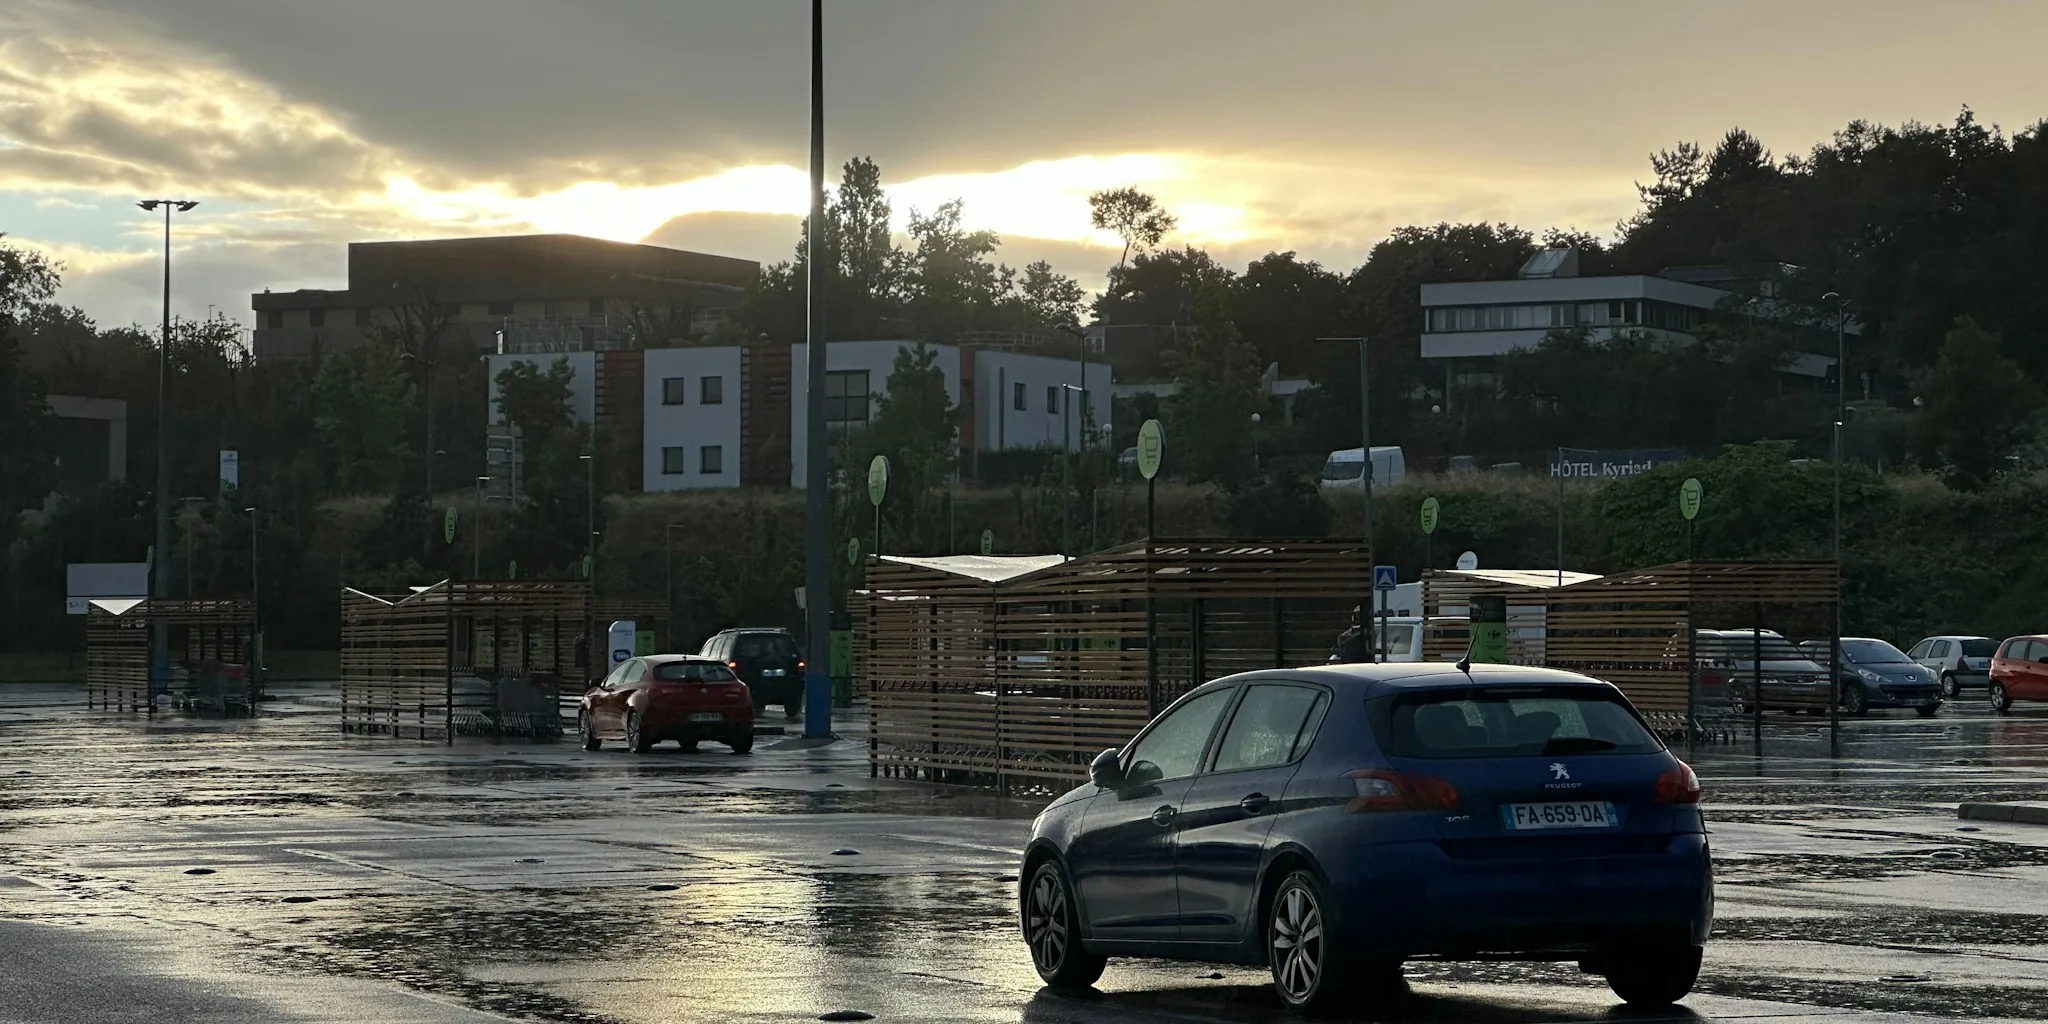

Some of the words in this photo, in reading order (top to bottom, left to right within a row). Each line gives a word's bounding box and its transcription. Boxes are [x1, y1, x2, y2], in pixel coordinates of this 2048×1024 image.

[1550, 459, 1598, 477] HÔTEL
[1601, 459, 1652, 479] Kyriad
[1515, 804, 1604, 825] FA-659-DA
